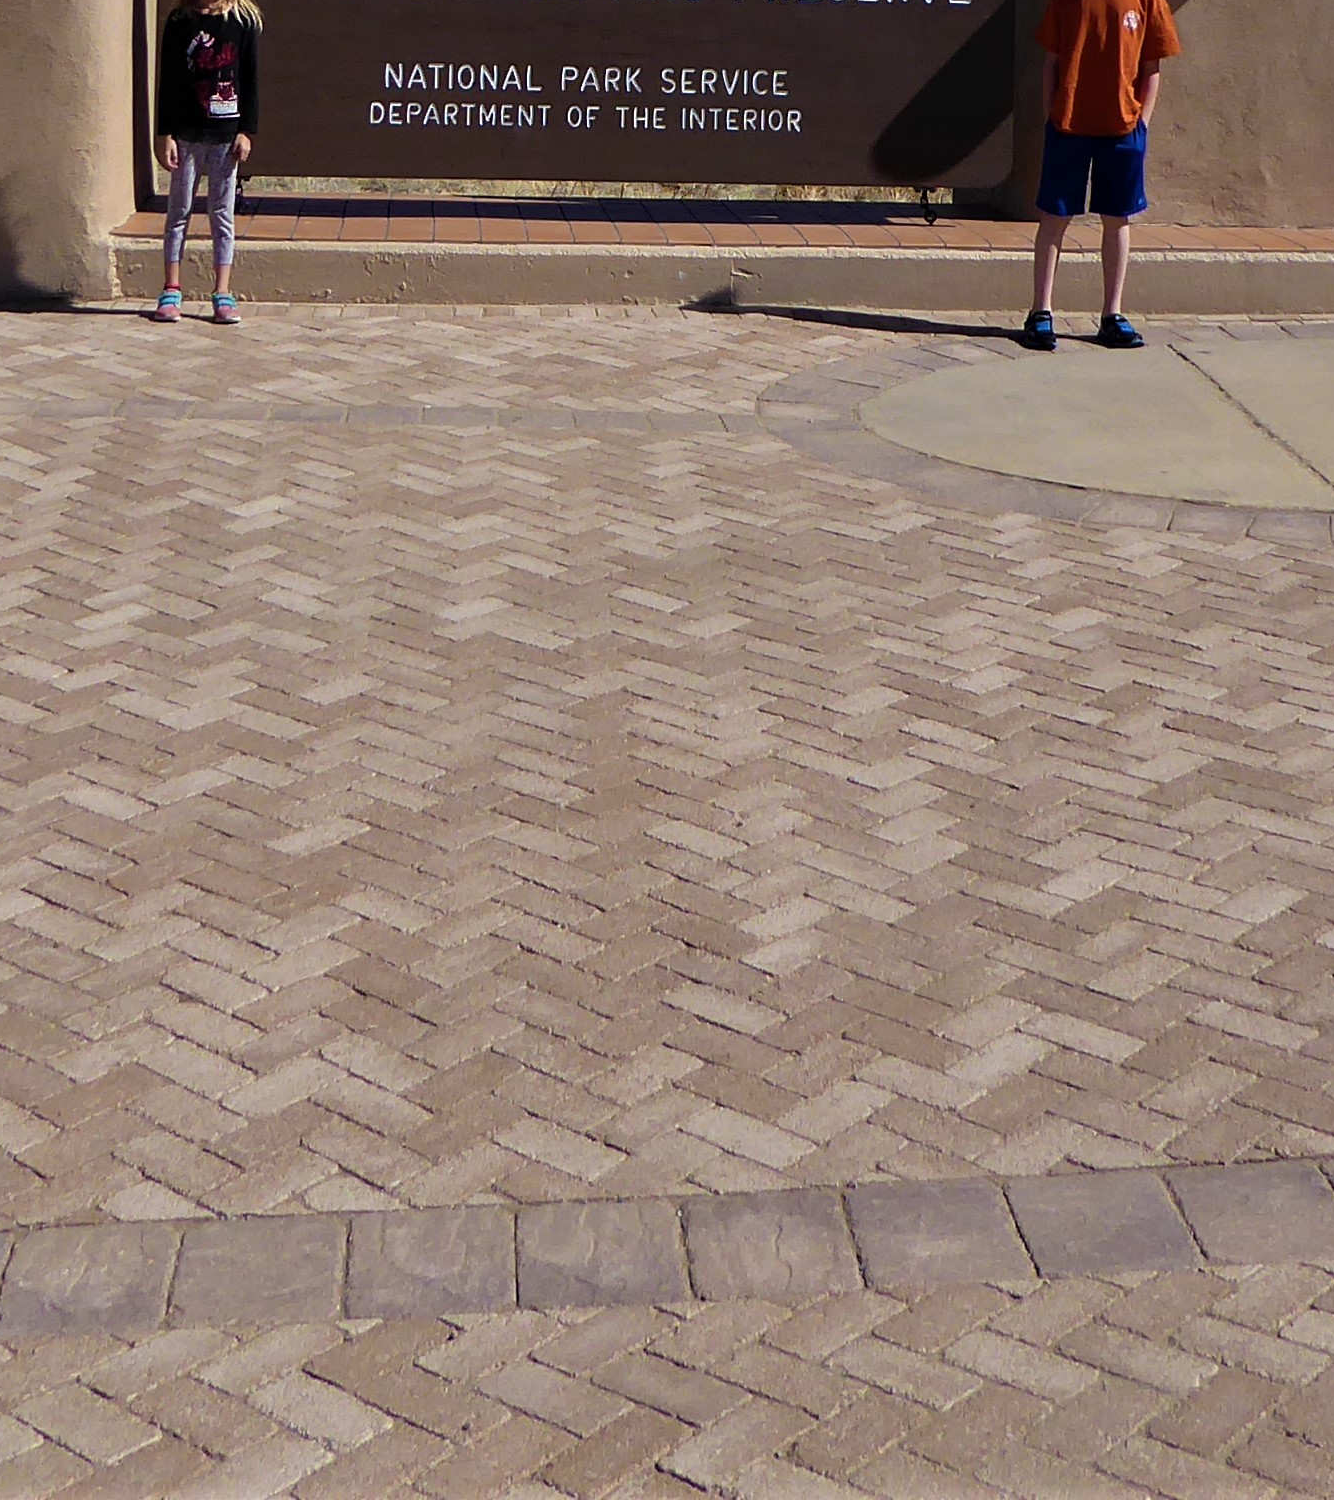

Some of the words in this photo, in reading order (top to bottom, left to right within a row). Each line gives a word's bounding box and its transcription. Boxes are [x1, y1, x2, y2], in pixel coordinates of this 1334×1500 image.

[384, 62, 542, 92] NATIONAL
[561, 66, 642, 93] PARK
[661, 68, 789, 97] SERVICE
[369, 101, 552, 129] DEPARTMENT
[567, 105, 600, 129] OF
[615, 106, 666, 130] THE
[681, 107, 803, 133] INTERIOR
